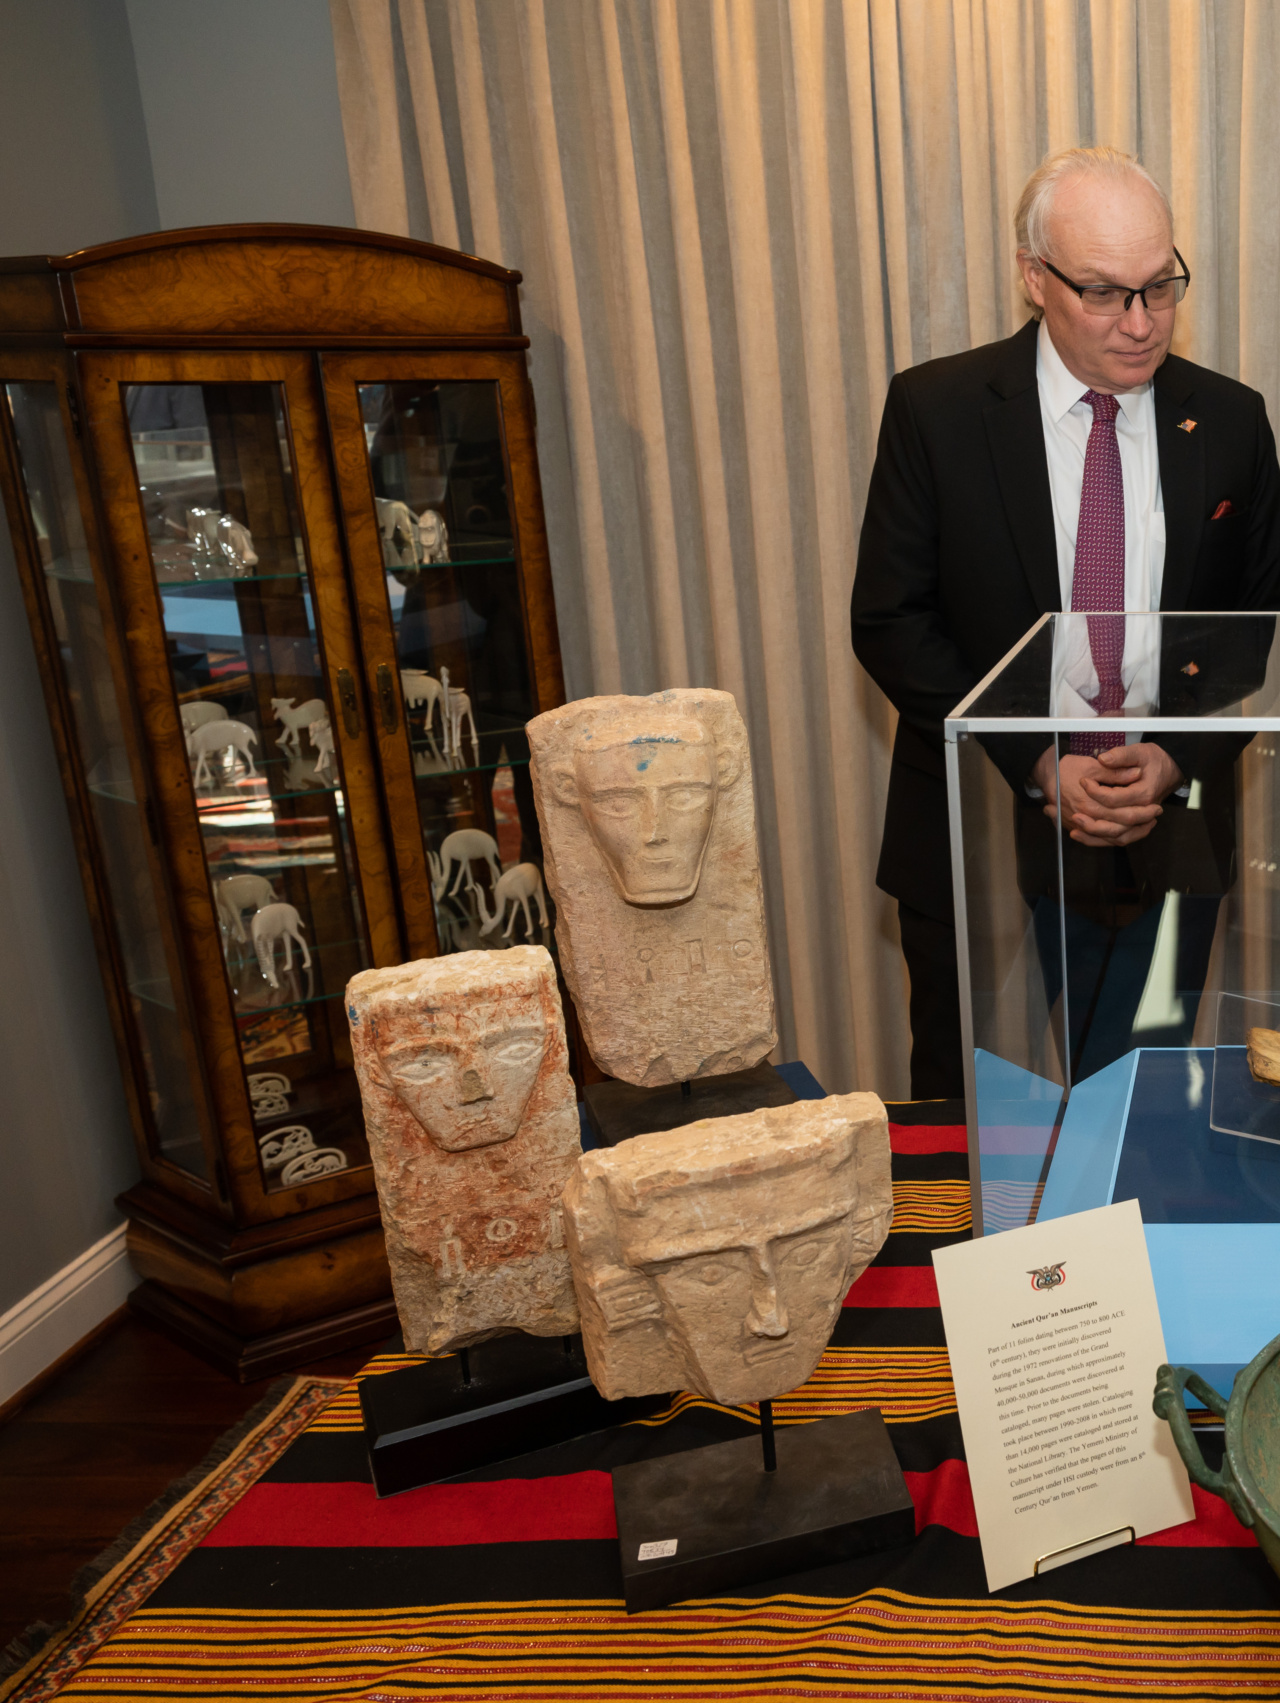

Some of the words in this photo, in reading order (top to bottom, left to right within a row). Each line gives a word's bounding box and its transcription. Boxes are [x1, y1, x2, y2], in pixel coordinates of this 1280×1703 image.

[987, 1346, 1000, 1355] Part
[1017, 1337, 1034, 1346] folios
[1035, 1332, 1054, 1340] dating
[1054, 1324, 1078, 1335] between
[1099, 1314, 1110, 1322] 800
[1111, 1310, 1125, 1319] ACE
[1011, 1318, 1035, 1329] Ancient
[1060, 1301, 1098, 1315] Manuscripts
[992, 1371, 1012, 1381] during
[1023, 1362, 1037, 1371] 1972
[1039, 1354, 1072, 1367] renovations
[1090, 1341, 1109, 1352] Grand
[1001, 1352, 1027, 1364] century),
[1042, 1344, 1056, 1352] were
[1058, 1337, 1079, 1347] initially
[1081, 1327, 1112, 1341] discovered
[994, 1383, 1018, 1394] Mosque
[1026, 1375, 1045, 1384] Sanaa,
[1047, 1369, 1066, 1378] during
[1067, 1362, 1084, 1372] which
[1086, 1351, 1126, 1367] approximately
[997, 1389, 1039, 1407] 40,000-50,000
[1040, 1381, 1071, 1394] documents
[1072, 1376, 1086, 1384] were
[1087, 1366, 1118, 1380] discovered
[1001, 1420, 1031, 1434] cataloged,
[1032, 1416, 1047, 1424] many
[1049, 1410, 1066, 1420] pages
[1067, 1405, 1081, 1413] were
[1082, 1400, 1102, 1408] stolen.
[1102, 1390, 1134, 1402] Cataloging
[1011, 1409, 1026, 1417] time.
[1027, 1403, 1041, 1412] Prior
[1060, 1389, 1091, 1401] documents
[1092, 1384, 1109, 1392] being
[1003, 1439, 1016, 1448] took
[1018, 1434, 1033, 1445] place
[1034, 1426, 1059, 1437] between
[1060, 1415, 1090, 1429] 1990-2008
[1099, 1407, 1116, 1417] which
[1117, 1404, 1132, 1412] more
[1005, 1453, 1019, 1461] than
[1020, 1445, 1040, 1456] 14,000
[1041, 1440, 1058, 1451] pages
[1059, 1435, 1073, 1443] were
[1074, 1425, 1101, 1439] cataloged
[1103, 1421, 1113, 1430] and
[1114, 1416, 1132, 1426] stored
[1018, 1457, 1043, 1470] National
[1044, 1452, 1068, 1462] Library.
[1081, 1438, 1104, 1450] Yemeni
[1105, 1432, 1129, 1442] Ministry
[1131, 1427, 1138, 1435] of
[1010, 1476, 1032, 1488] Culture
[1044, 1463, 1067, 1475] verified
[1068, 1460, 1079, 1468] that
[1090, 1452, 1107, 1462] pages
[1012, 1486, 1044, 1501] manuscript
[1046, 1480, 1062, 1490] under
[1063, 1474, 1075, 1484] HSI
[1076, 1468, 1098, 1479] custody
[1100, 1463, 1114, 1471] were
[1115, 1459, 1129, 1467] from
[1014, 1503, 1037, 1515] Century
[1061, 1490, 1075, 1499] from
[1076, 1483, 1098, 1493] Yemen.
